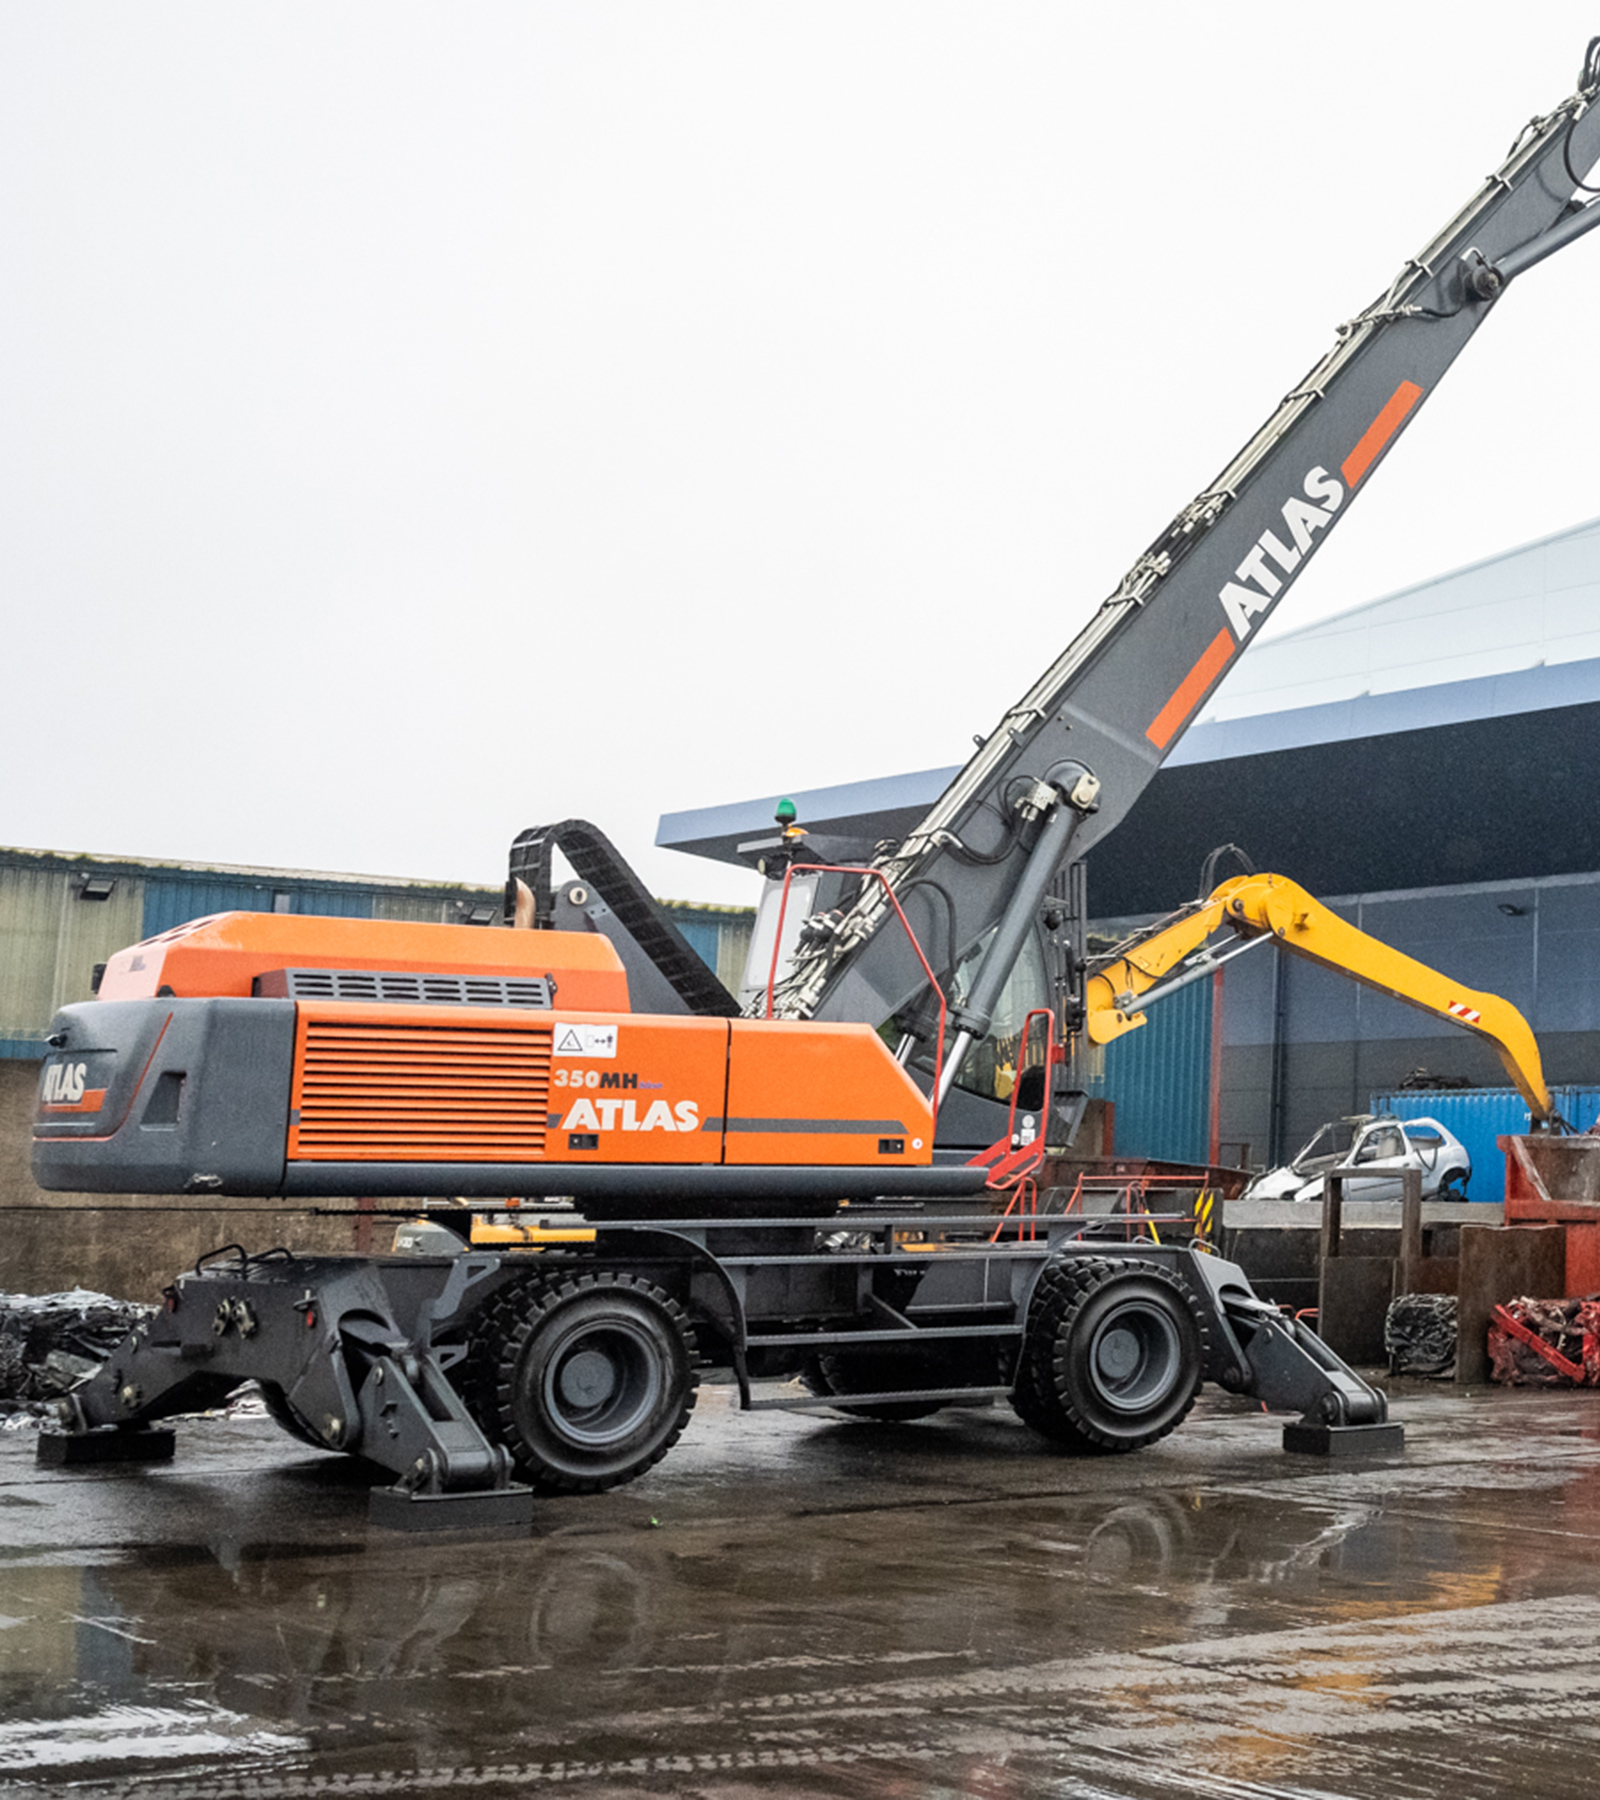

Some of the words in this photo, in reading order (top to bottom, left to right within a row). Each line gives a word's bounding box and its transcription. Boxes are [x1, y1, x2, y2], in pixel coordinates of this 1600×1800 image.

[1218, 466, 1344, 641] ATLAS
[42, 1063, 87, 1102] ATLAS
[563, 1099, 699, 1132] ATLAS
